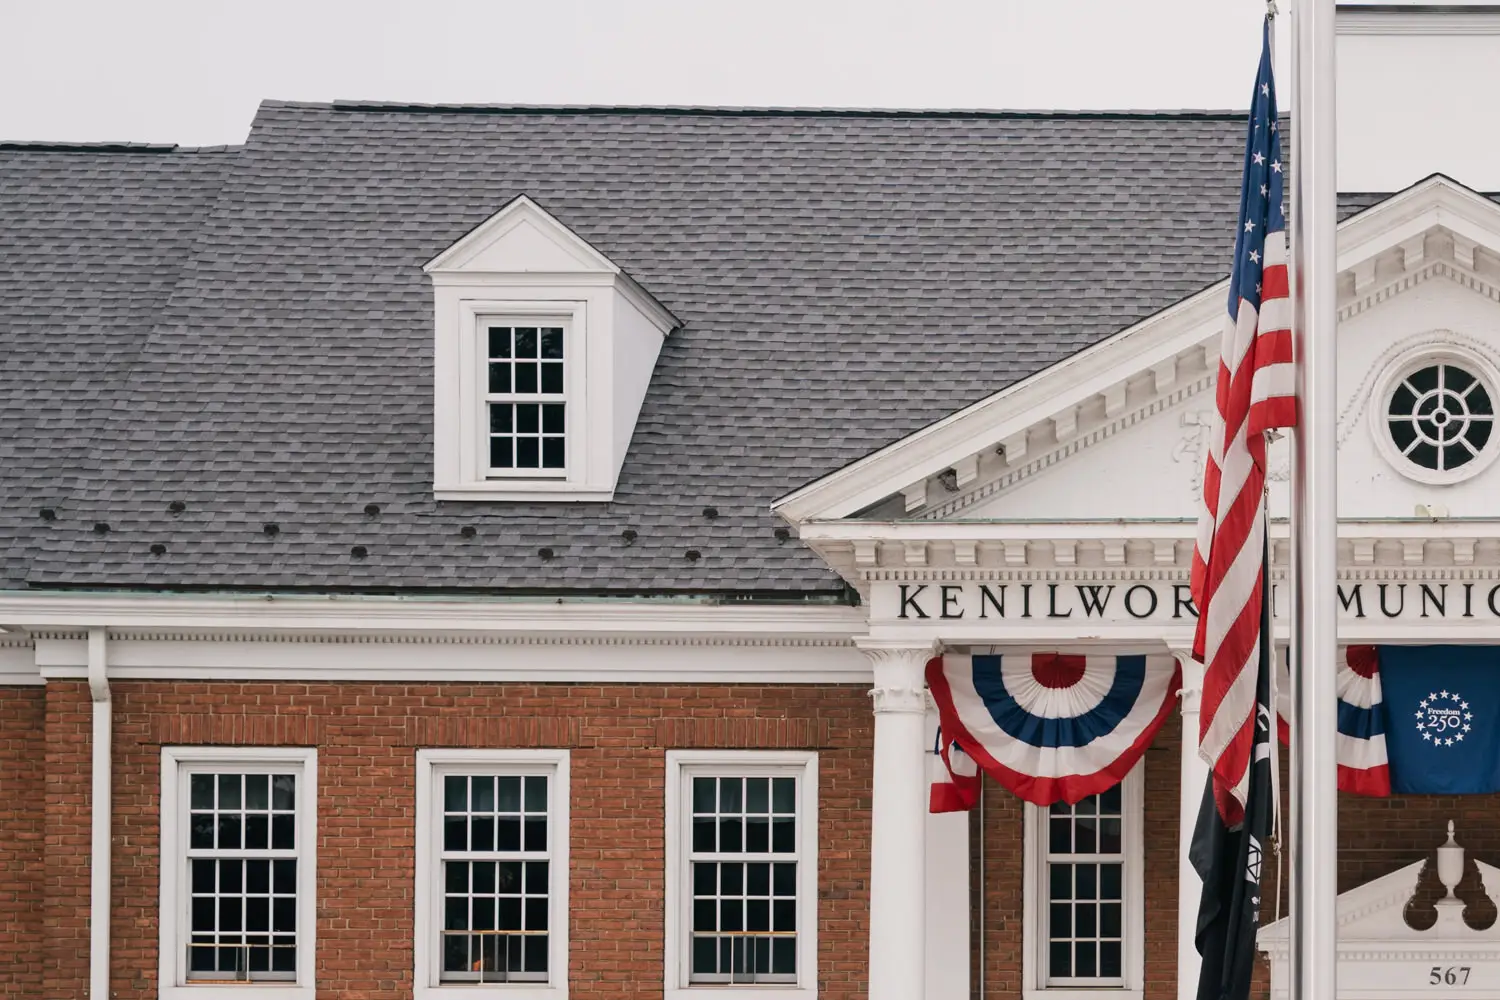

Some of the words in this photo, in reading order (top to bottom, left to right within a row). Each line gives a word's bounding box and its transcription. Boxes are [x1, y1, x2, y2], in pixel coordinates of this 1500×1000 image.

[897, 584, 1278, 619] KENILWOR
[1427, 707, 1461, 716] Freedom
[1427, 715, 1461, 733] 250
[1429, 966, 1472, 985] 567
